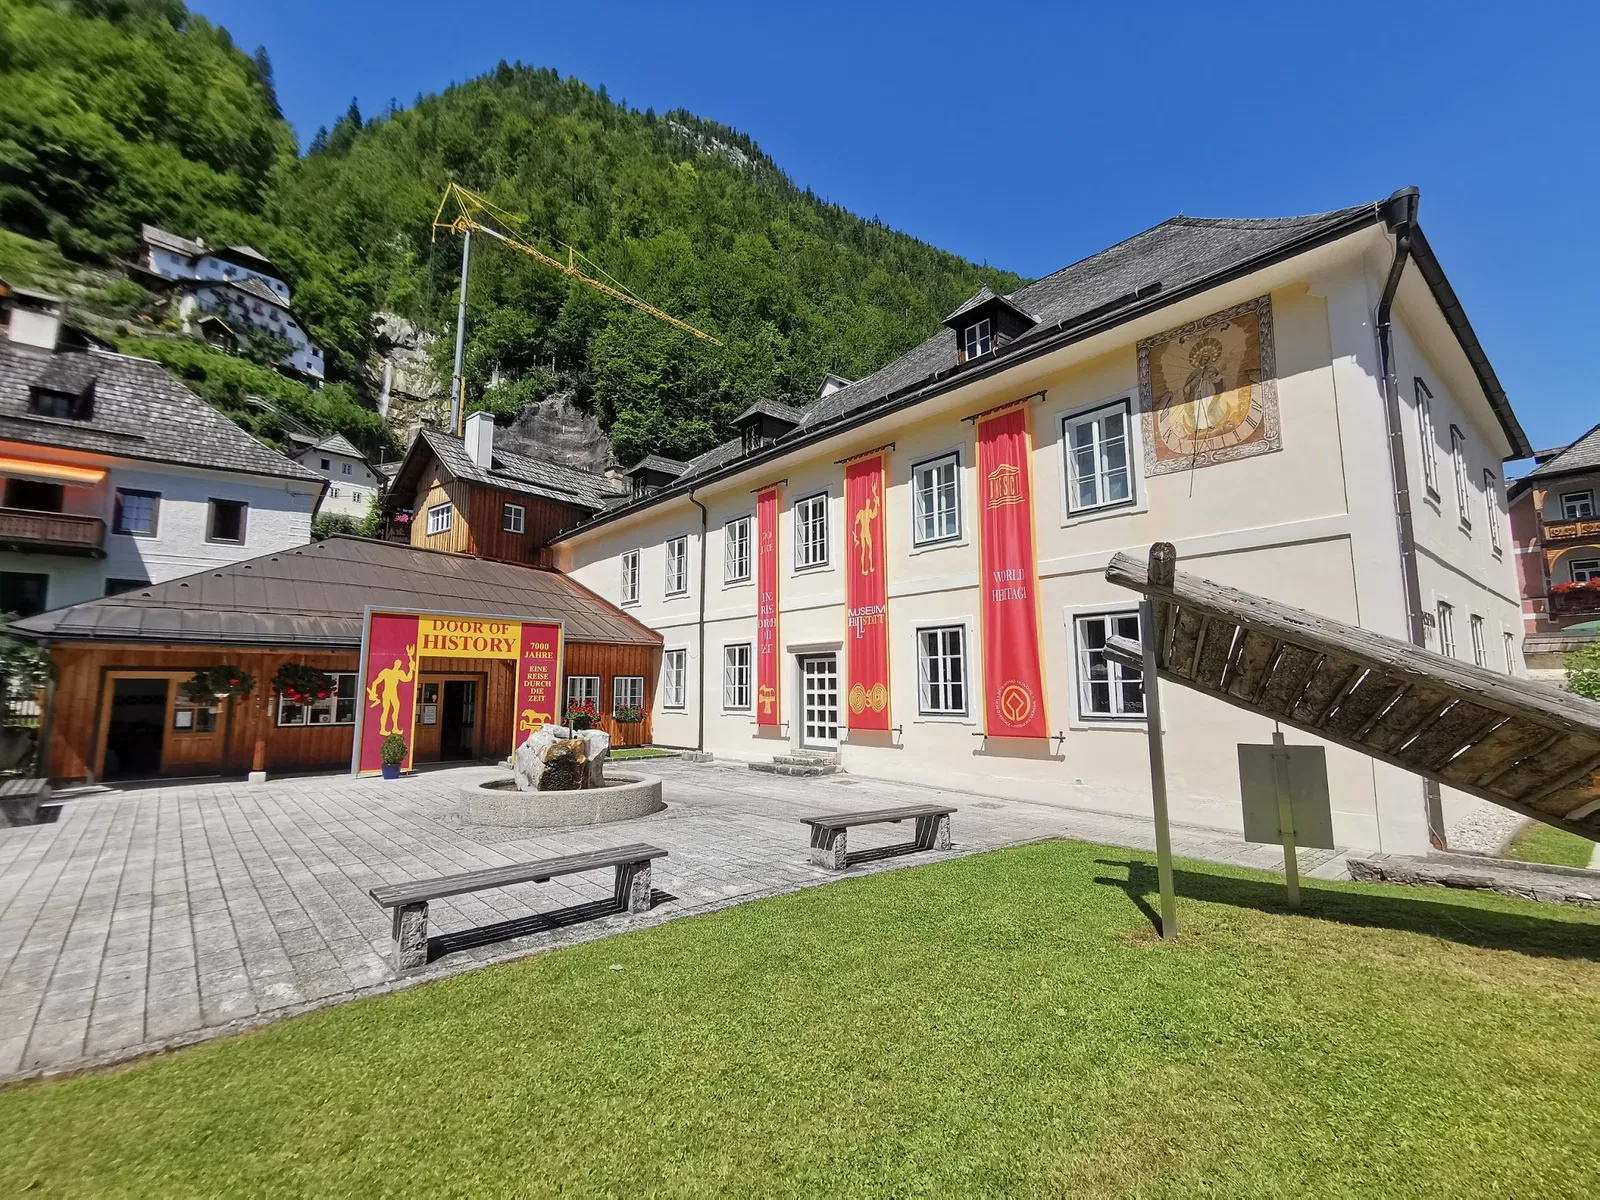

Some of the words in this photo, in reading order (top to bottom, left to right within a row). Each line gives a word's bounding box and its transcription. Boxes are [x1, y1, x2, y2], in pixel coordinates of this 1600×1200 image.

[432, 619, 483, 634] DOOR
[489, 622, 510, 635] OF
[423, 634, 516, 652] HISTORY
[530, 642, 549, 651] 7000
[524, 651, 553, 660] JAHRE
